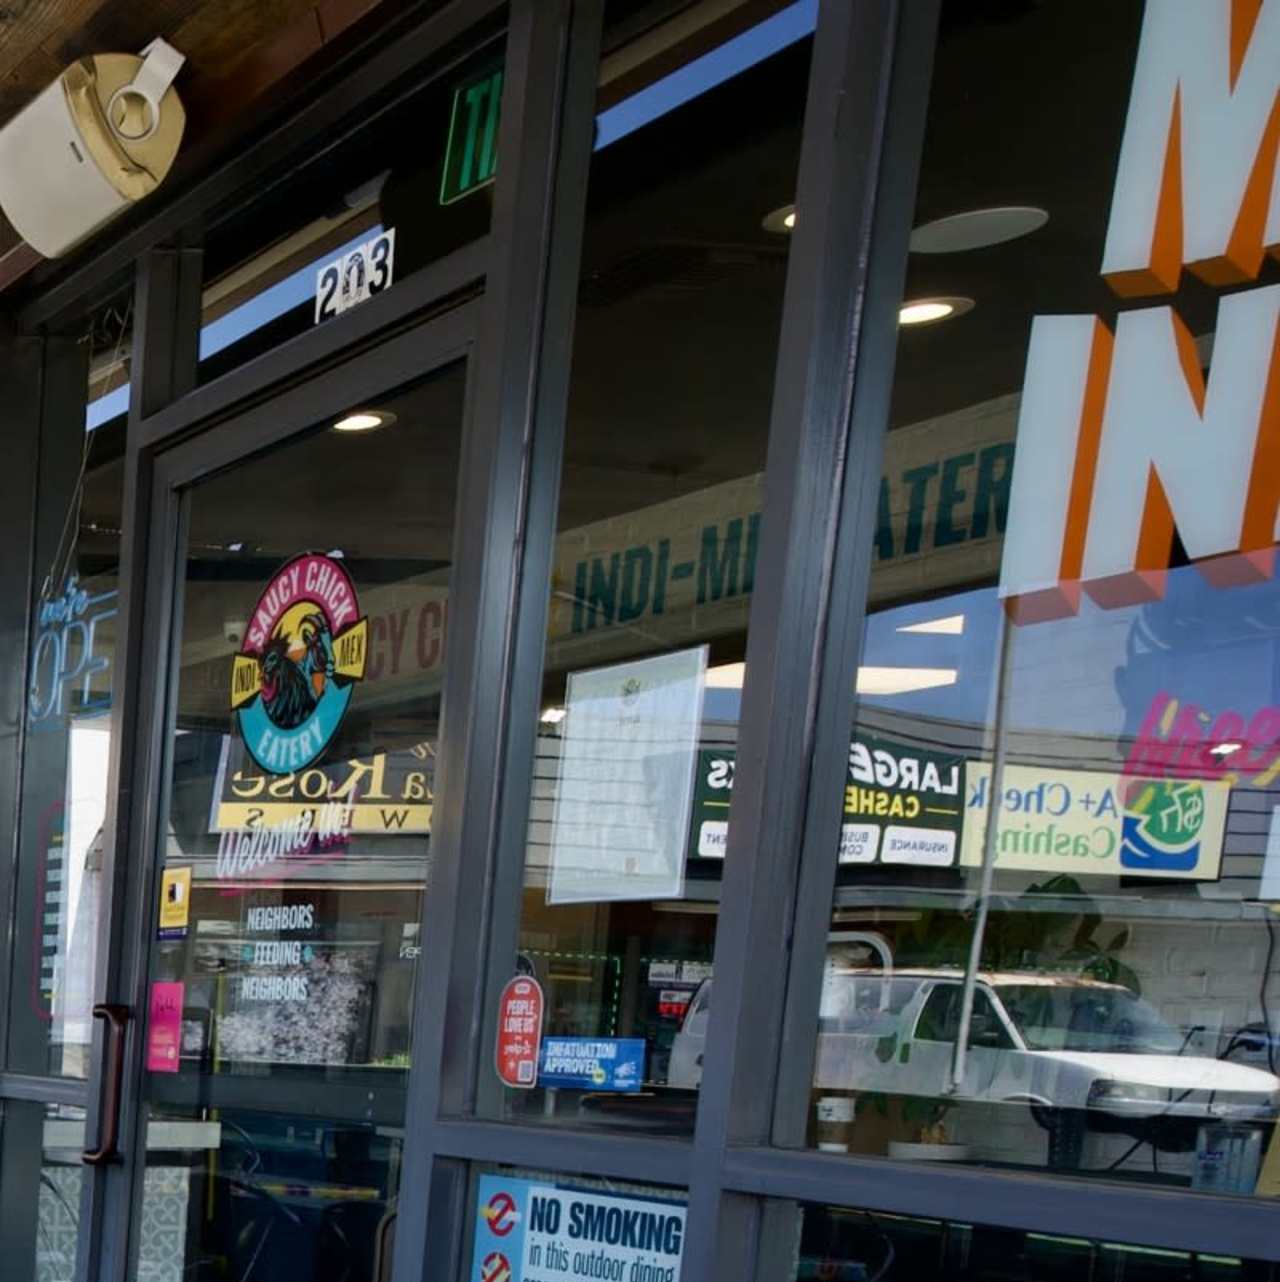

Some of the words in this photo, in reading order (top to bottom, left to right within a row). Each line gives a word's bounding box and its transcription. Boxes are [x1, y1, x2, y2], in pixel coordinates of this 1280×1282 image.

[319, 237, 389, 319] 203
[249, 564, 301, 648] SAUCY
[304, 560, 354, 627] CHICK
[339, 637, 363, 669] MEX
[257, 717, 324, 769] EATERY
[215, 808, 312, 879] Welcome
[247, 904, 314, 931] NEIGHBORS
[253, 941, 302, 966] FEEDING
[239, 976, 309, 1001] NEIGHBORS
[529, 1194, 562, 1235] NO
[568, 1201, 682, 1256] SMOKING
[528, 1237, 542, 1266] in
[545, 1240, 569, 1272] this
